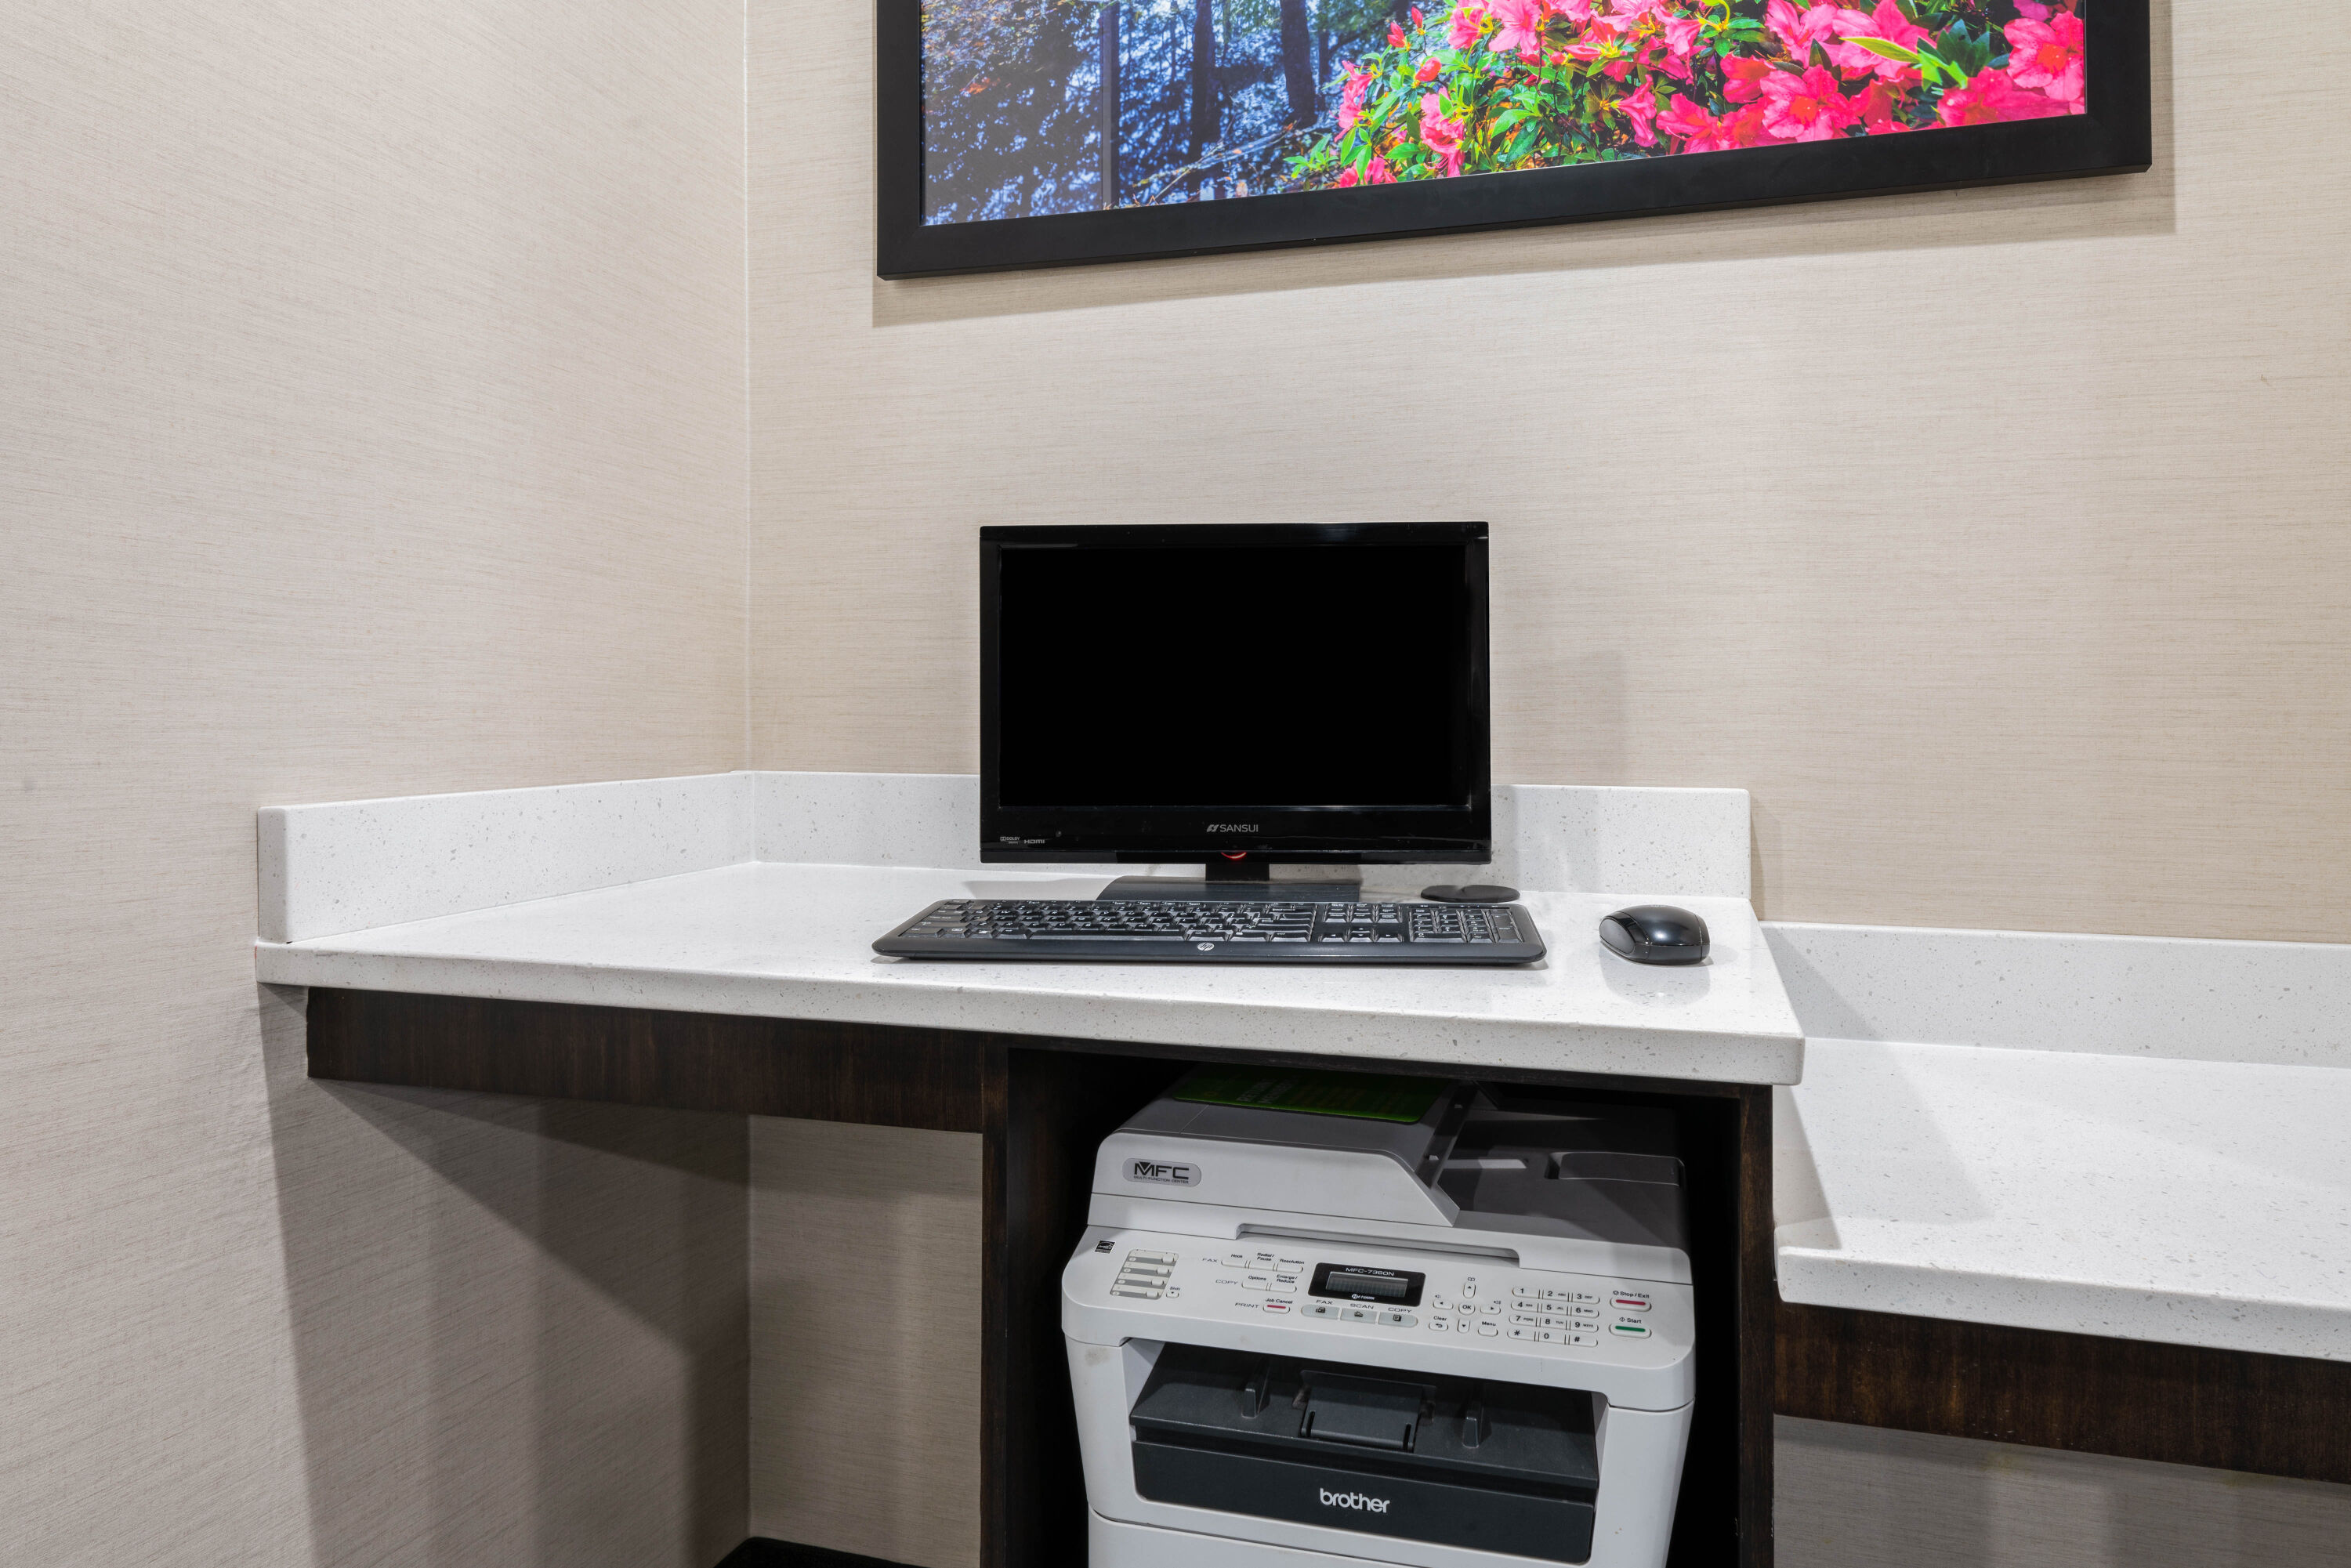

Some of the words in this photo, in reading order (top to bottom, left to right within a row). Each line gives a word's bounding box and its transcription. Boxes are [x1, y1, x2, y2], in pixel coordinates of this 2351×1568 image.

[1219, 824, 1259, 832] SANSUI
[1134, 1161, 1190, 1180] MFC
[1320, 1487, 1390, 1513] brother
